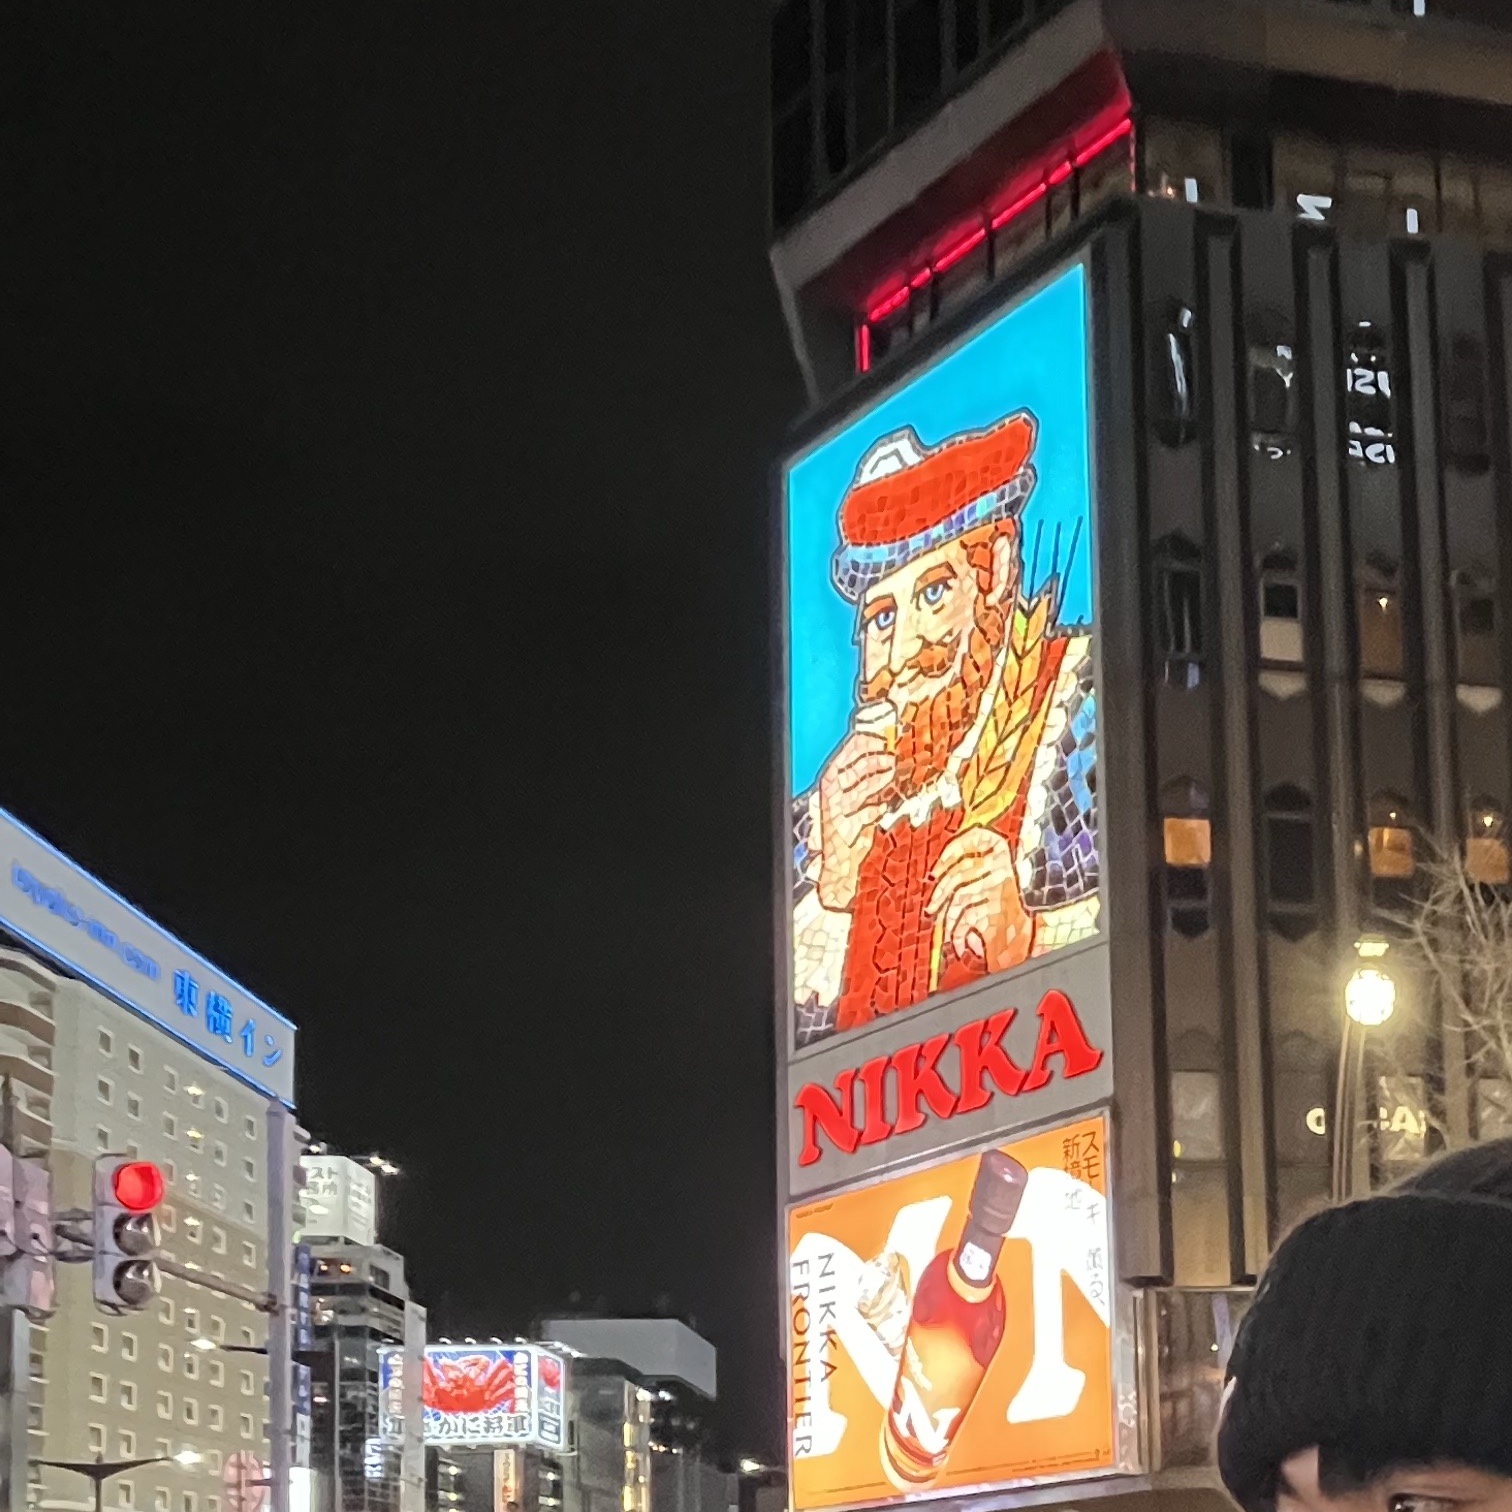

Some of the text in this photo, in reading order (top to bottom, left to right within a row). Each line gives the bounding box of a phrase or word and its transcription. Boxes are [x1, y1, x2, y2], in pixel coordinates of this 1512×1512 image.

[173, 968, 283, 1066] 東横イン
[794, 989, 1104, 1166] NIKKA
[791, 1259, 813, 1457] FRONTIER
[818, 1253, 838, 1382] NIKKA
